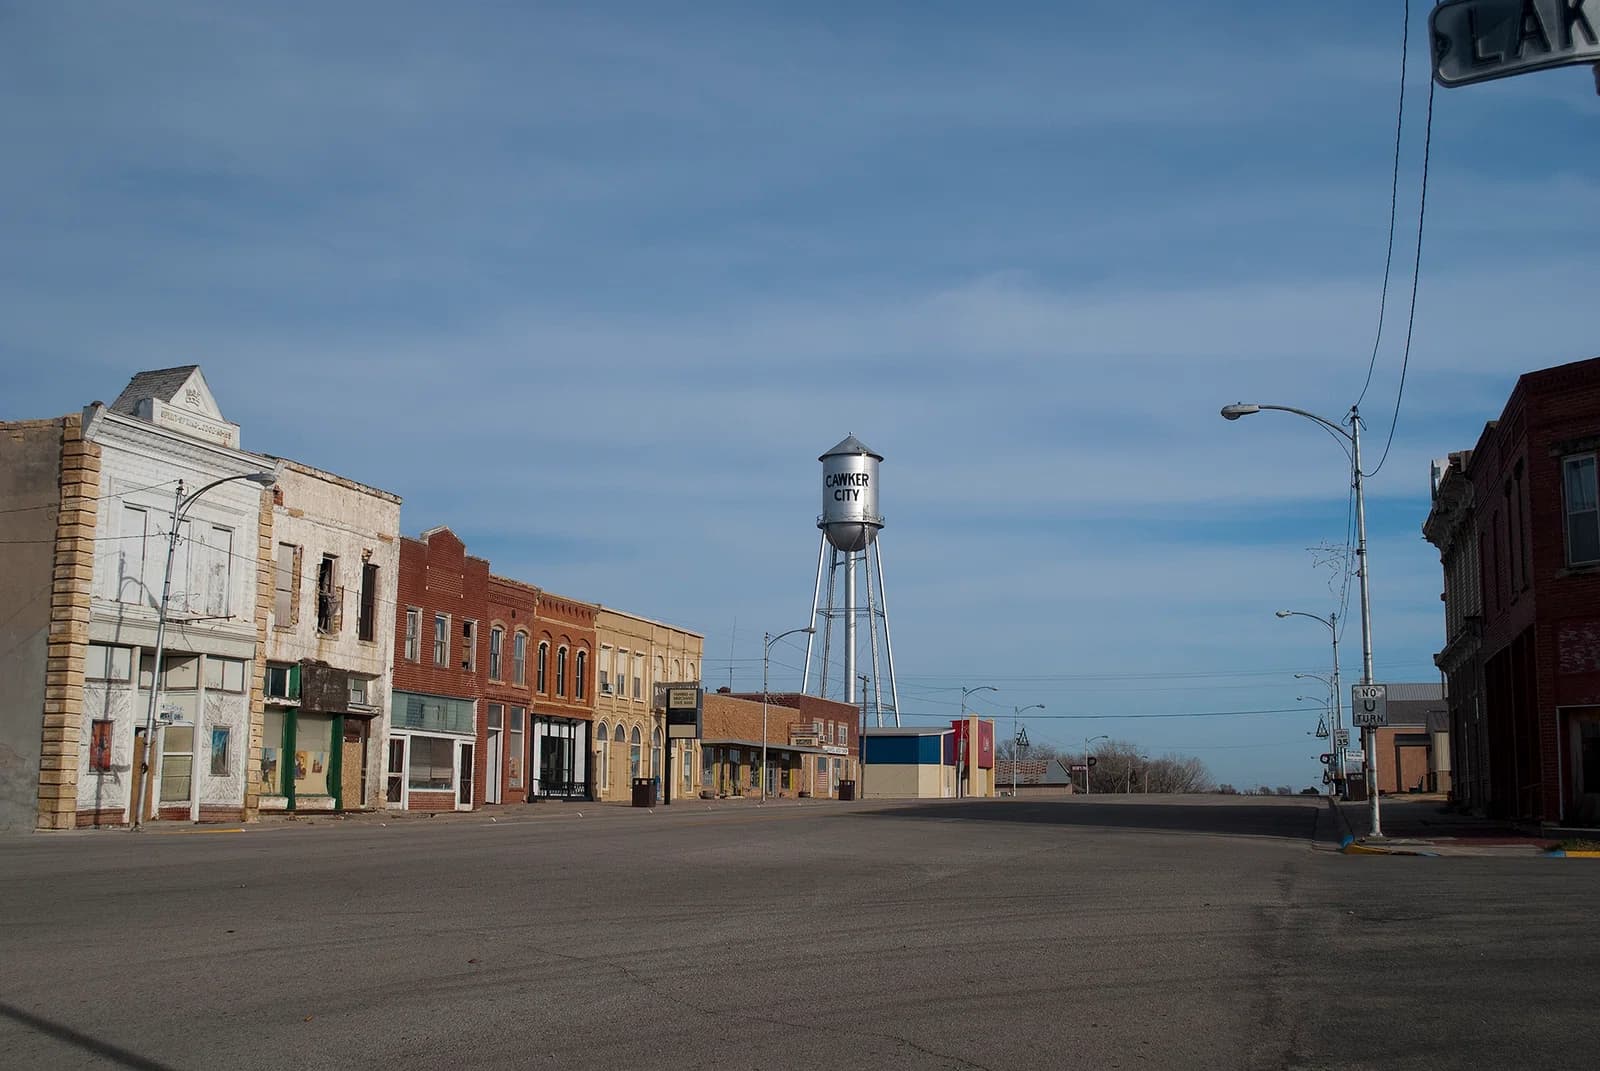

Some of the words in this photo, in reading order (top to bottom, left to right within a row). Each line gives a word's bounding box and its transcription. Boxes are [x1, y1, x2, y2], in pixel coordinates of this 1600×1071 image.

[825, 472, 869, 488] CAWKER
[834, 488, 860, 502] CITY
[1362, 688, 1376, 697] NO
[1364, 700, 1375, 712] U
[1356, 713, 1384, 723] TURN
[1336, 738, 1349, 746] 35
